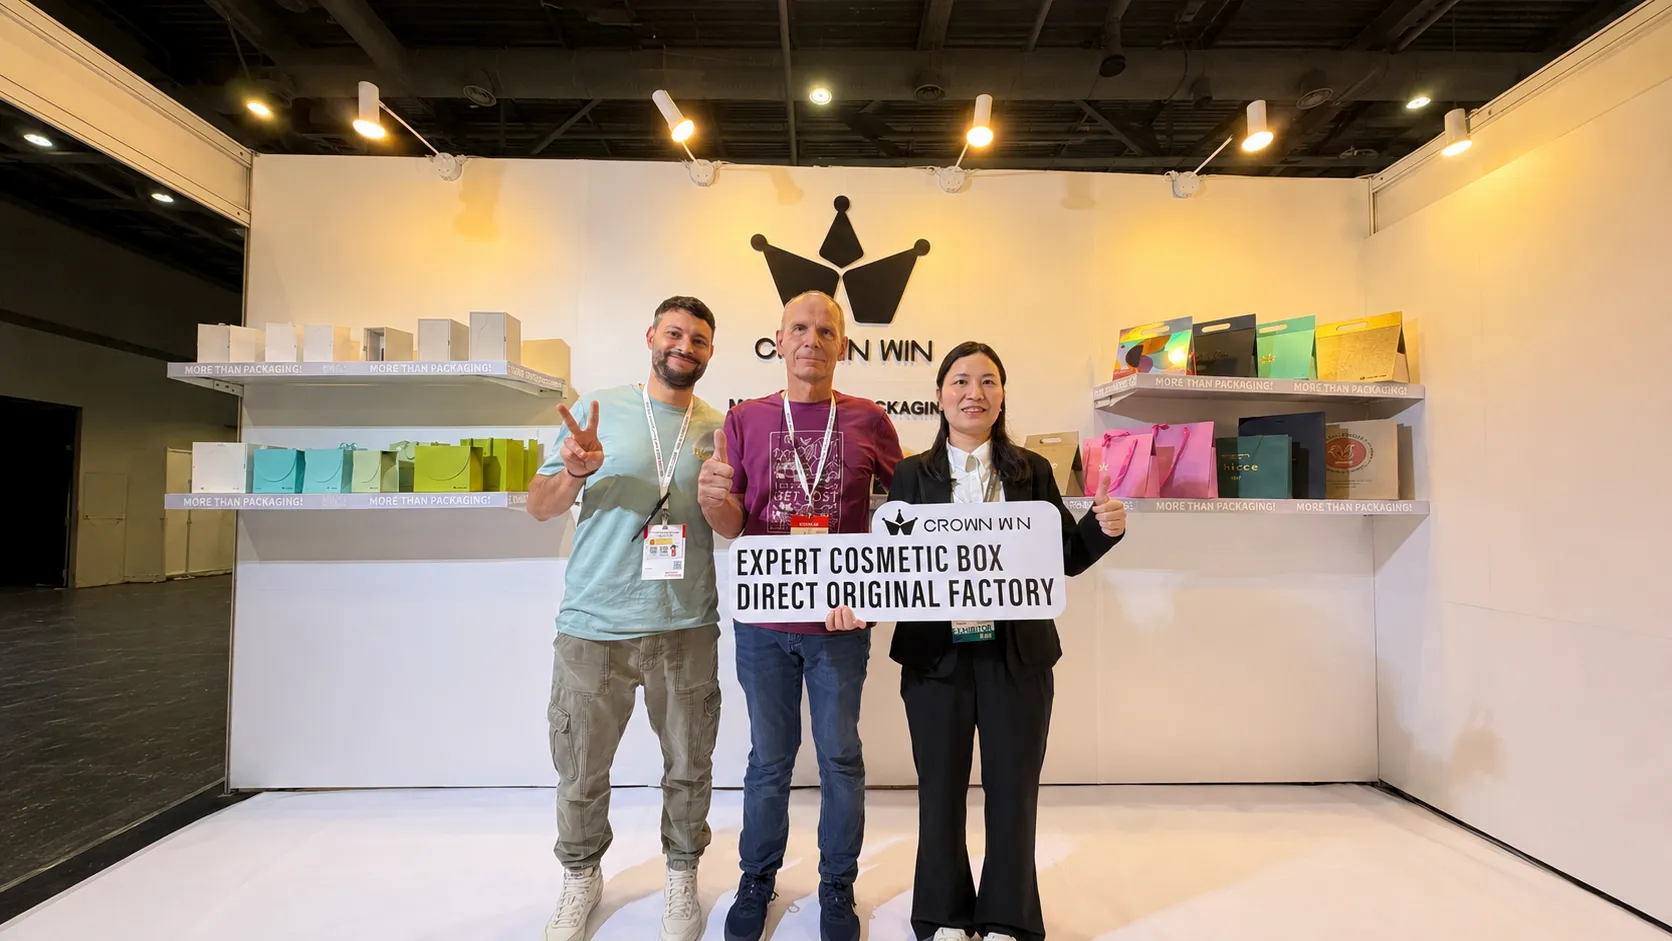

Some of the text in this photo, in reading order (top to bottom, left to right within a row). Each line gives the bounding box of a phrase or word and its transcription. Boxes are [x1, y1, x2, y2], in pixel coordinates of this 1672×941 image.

[880, 339, 932, 362] WIN
[185, 364, 302, 375] MORE THAN PACKAGING!
[370, 363, 492, 373] MORE THAN PACKAGING!
[1155, 377, 1274, 390] MORE THAN PACKAGING!
[1294, 382, 1322, 392] MORE
[1323, 383, 1349, 393] THAN
[875, 400, 940, 415] KAGIN
[183, 497, 303, 507] MORE THAN PACKAGING!
[369, 495, 491, 506] MORE THAN PACKAGING!
[1156, 501, 1276, 512] MORE THAN PACKAGING!
[1296, 502, 1412, 512] MORE THAN PACKAGING!
[924, 517, 992, 532] CROWN
[737, 544, 1003, 576] EXPERT COSMETIC BOX
[737, 578, 1054, 610] DIRECT ORIGINAL FACTORY
